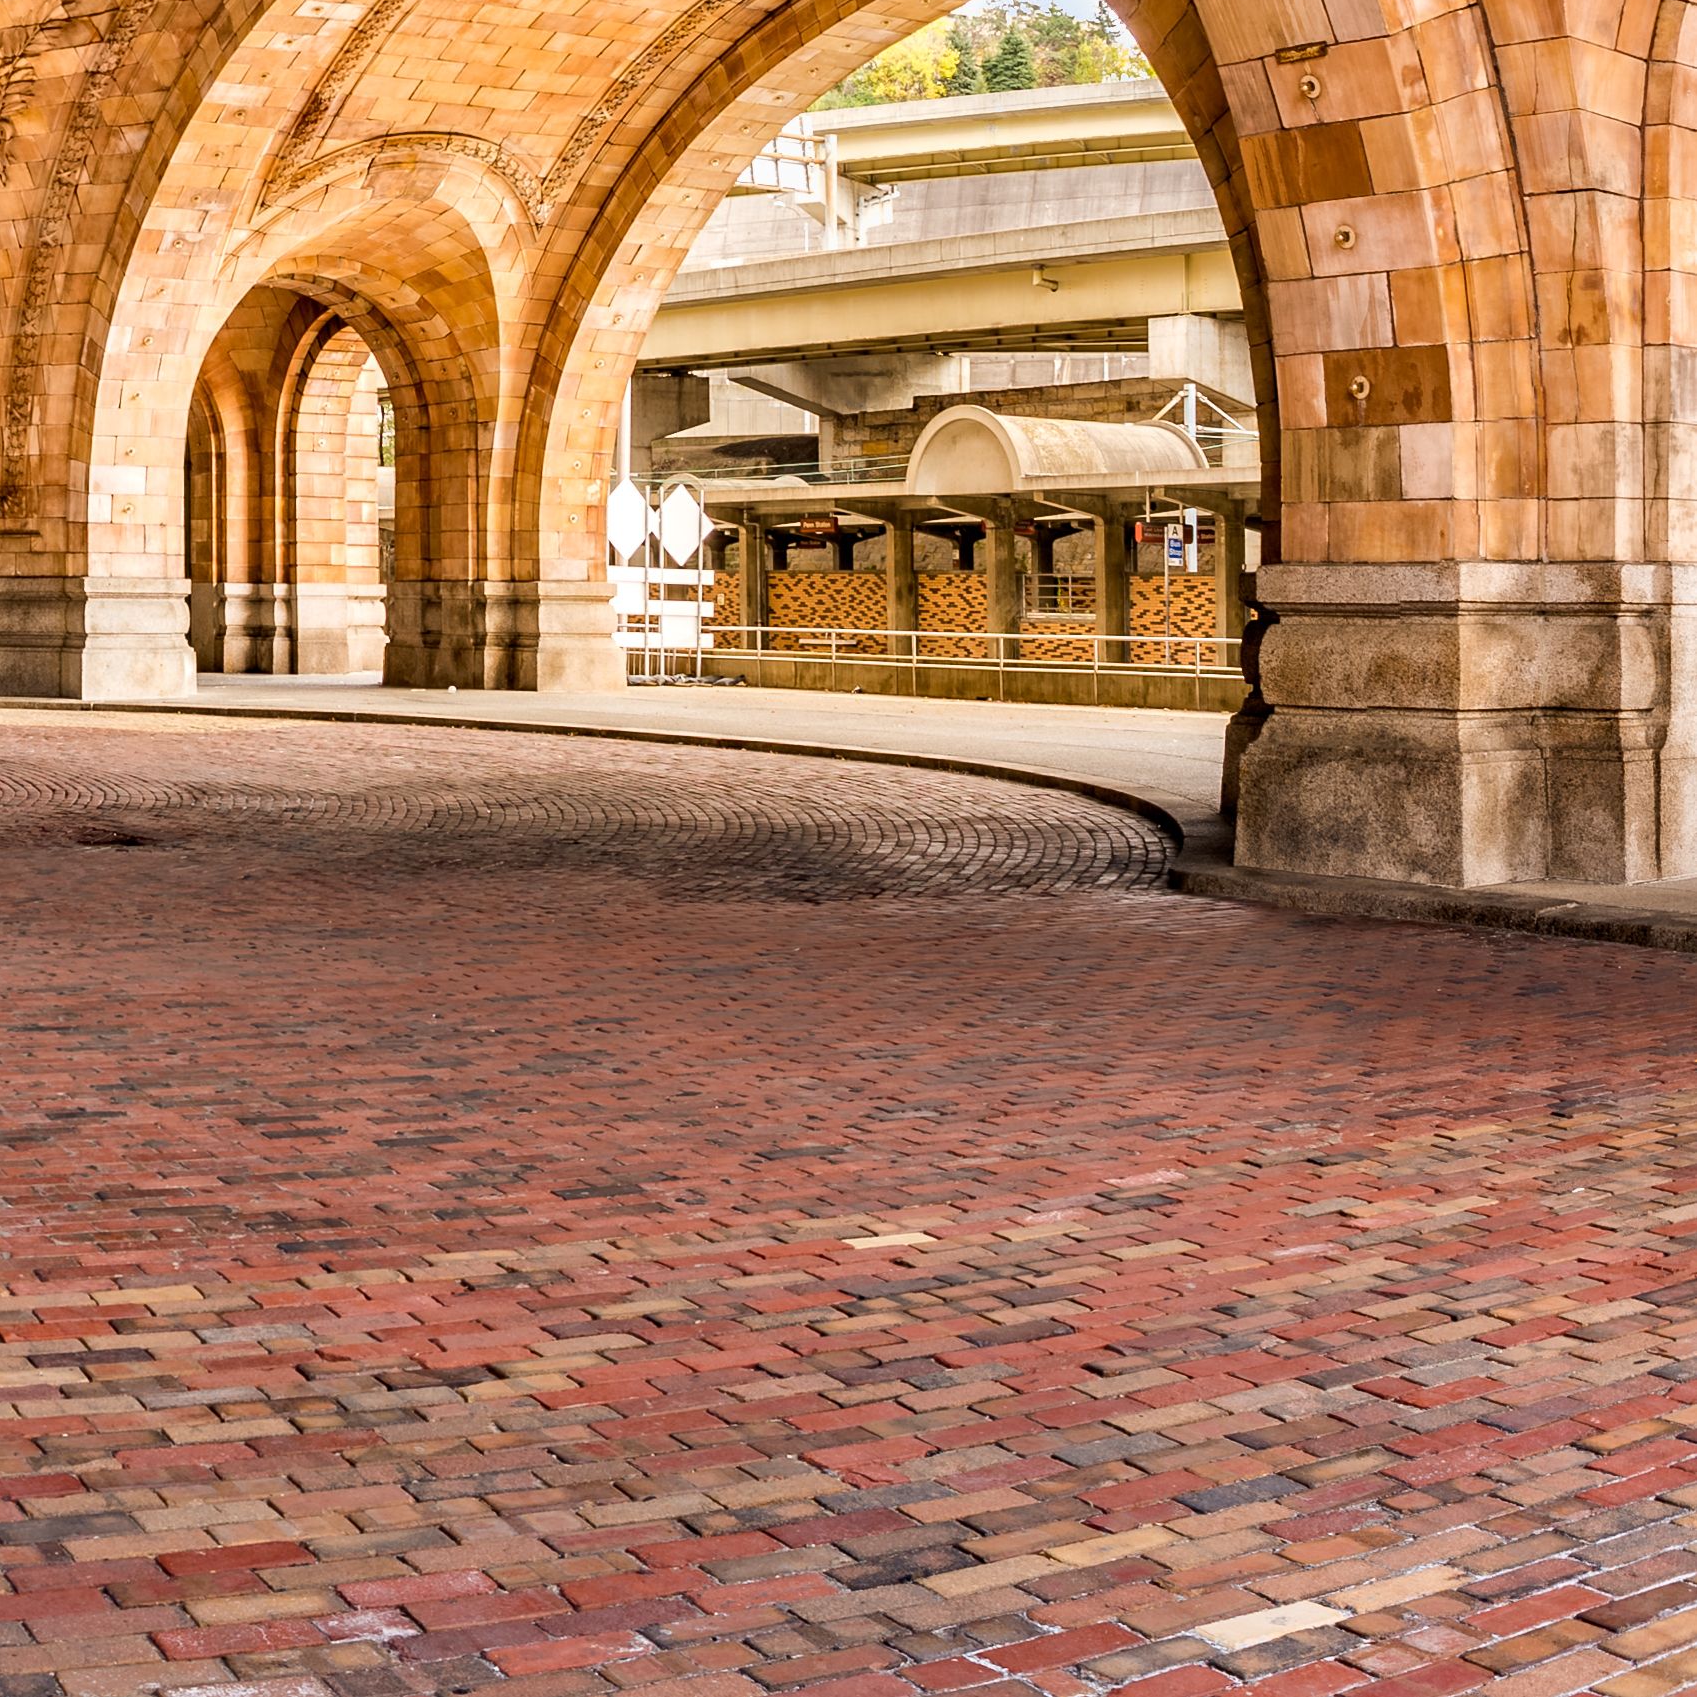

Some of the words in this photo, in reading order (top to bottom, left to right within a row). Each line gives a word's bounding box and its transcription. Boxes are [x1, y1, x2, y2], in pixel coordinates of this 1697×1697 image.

[1172, 526, 1178, 536] A
[1170, 539, 1181, 547] Bus
[1169, 547, 1182, 556] Stop
